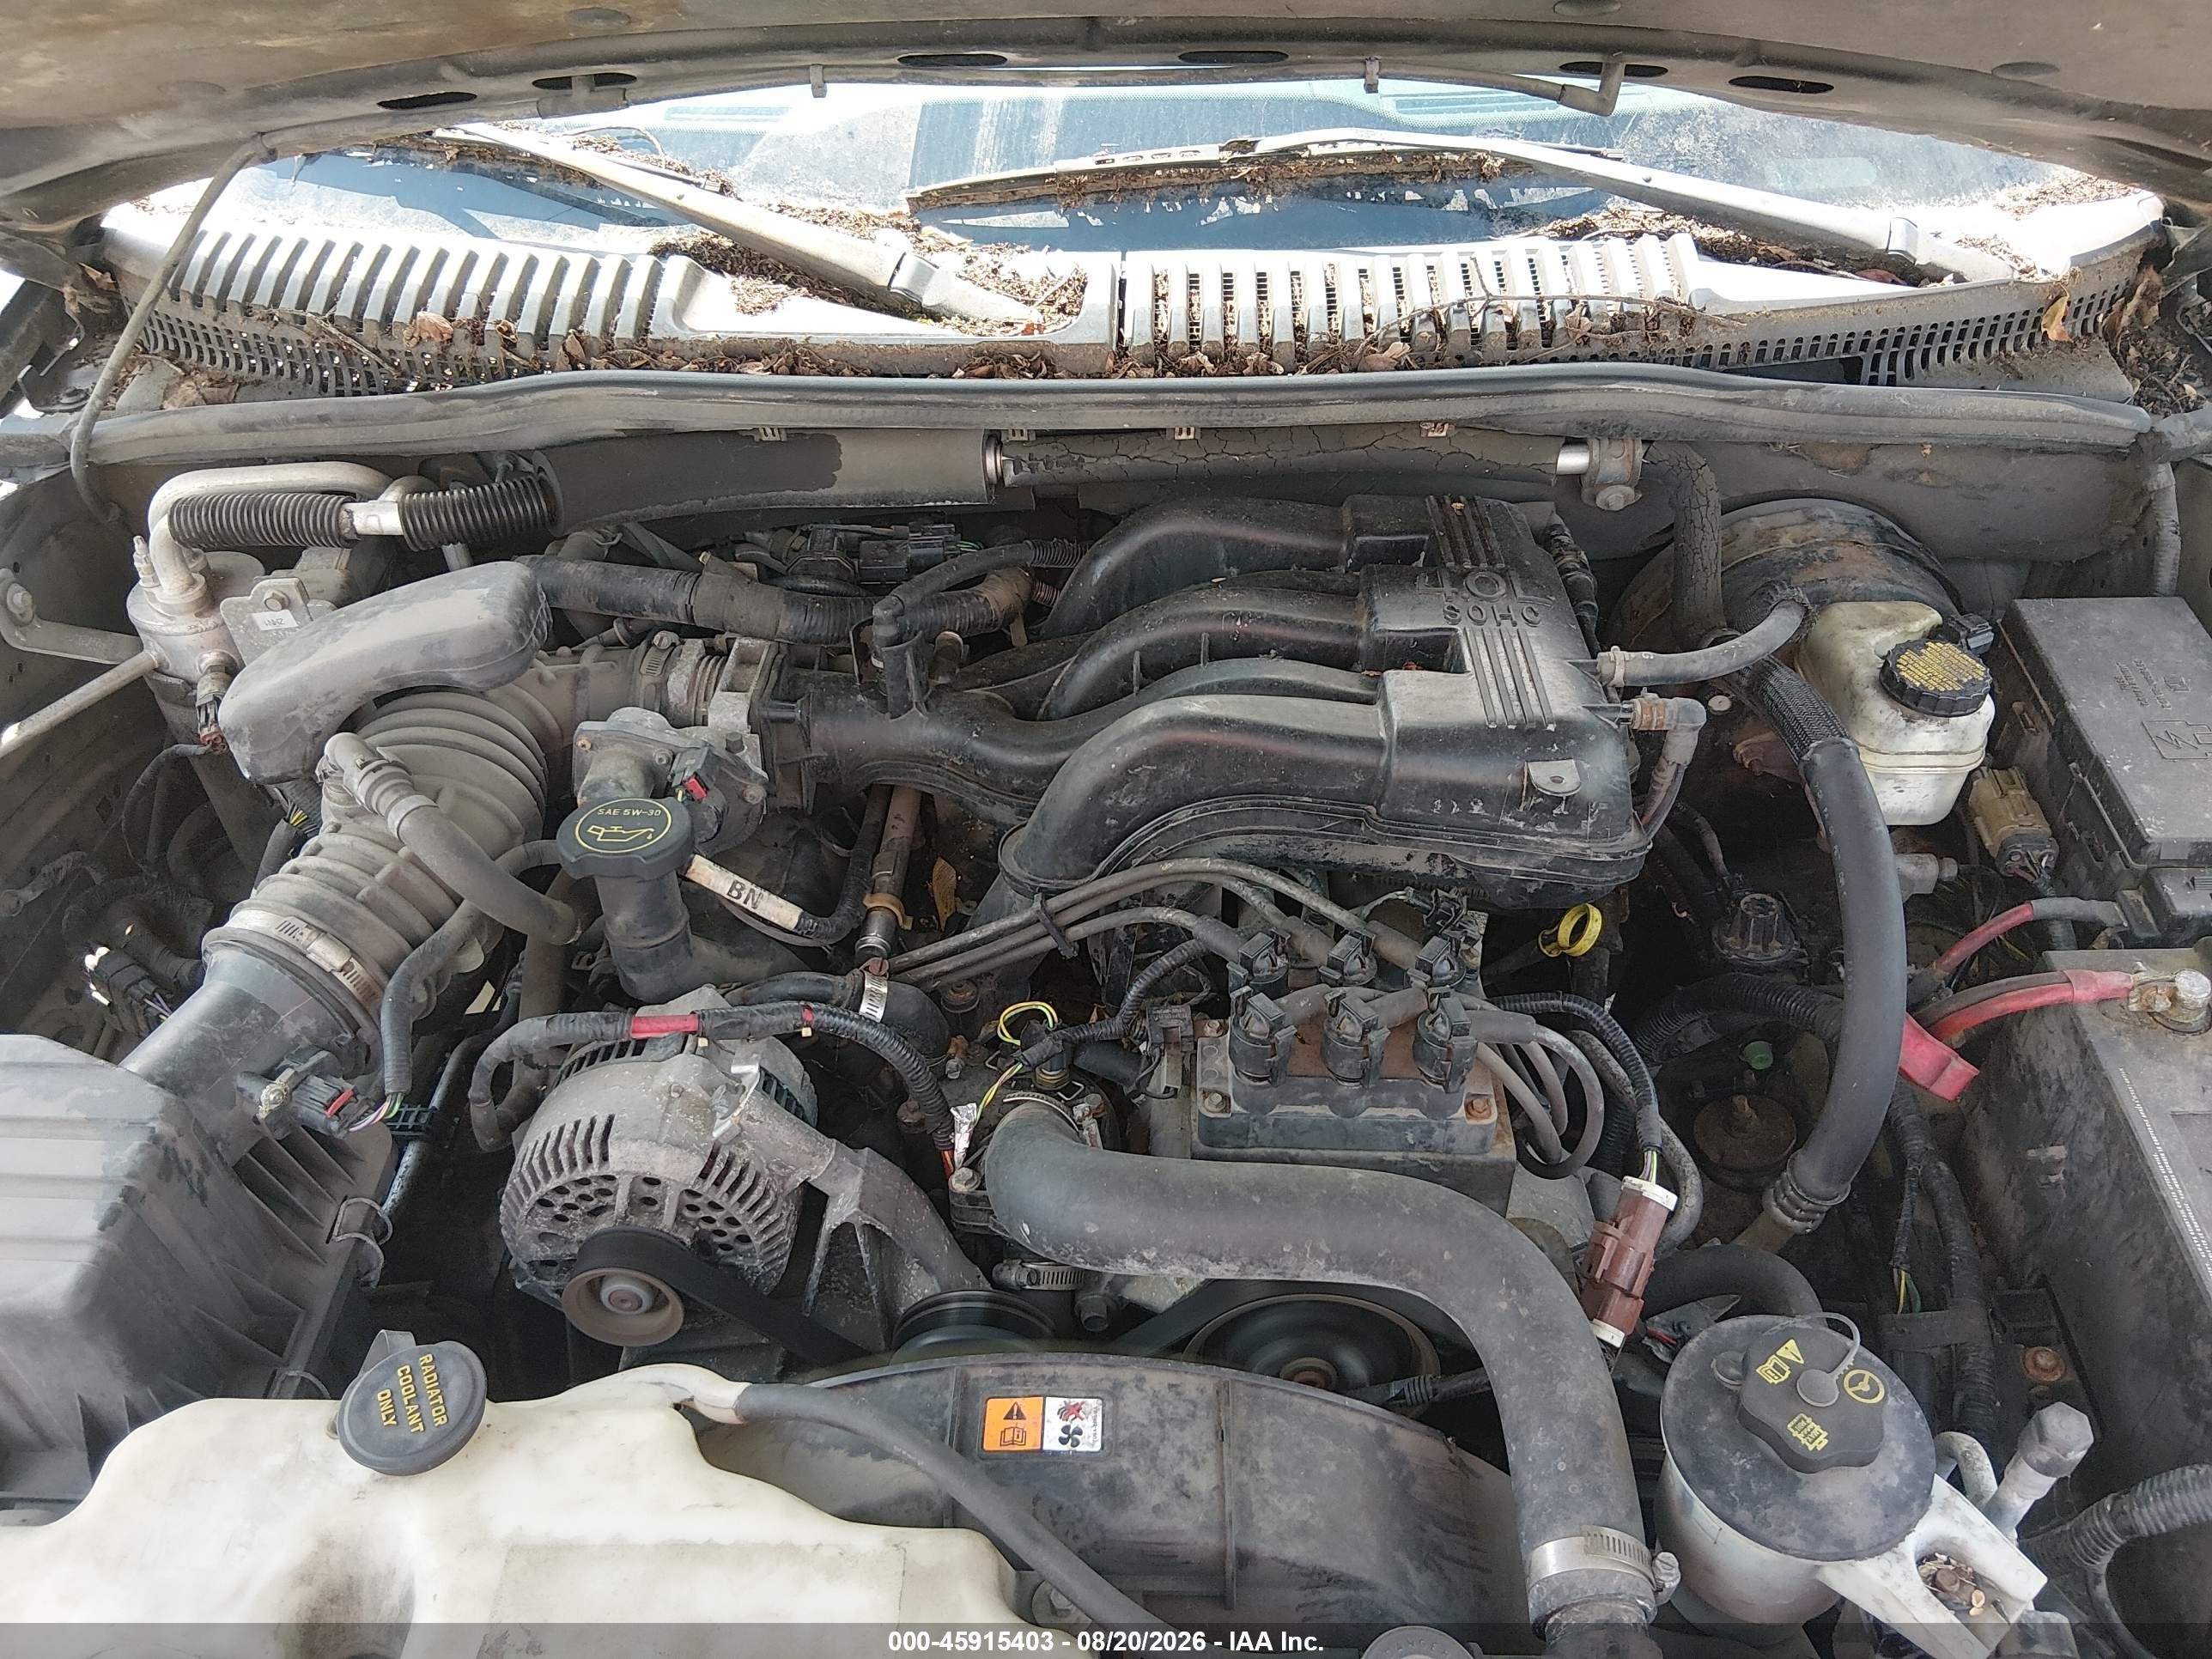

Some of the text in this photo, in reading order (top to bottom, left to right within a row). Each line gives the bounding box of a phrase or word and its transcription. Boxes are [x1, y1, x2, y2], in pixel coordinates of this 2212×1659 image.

[1417, 570, 1555, 606] 4.0L
[1443, 603, 1542, 627] SOHC
[623, 808, 662, 817] 5W-30
[726, 879, 763, 910] BN
[377, 1389, 398, 1426] ONLY
[398, 1364, 424, 1432] COOLANT
[419, 1353, 448, 1426] RADIATOR
